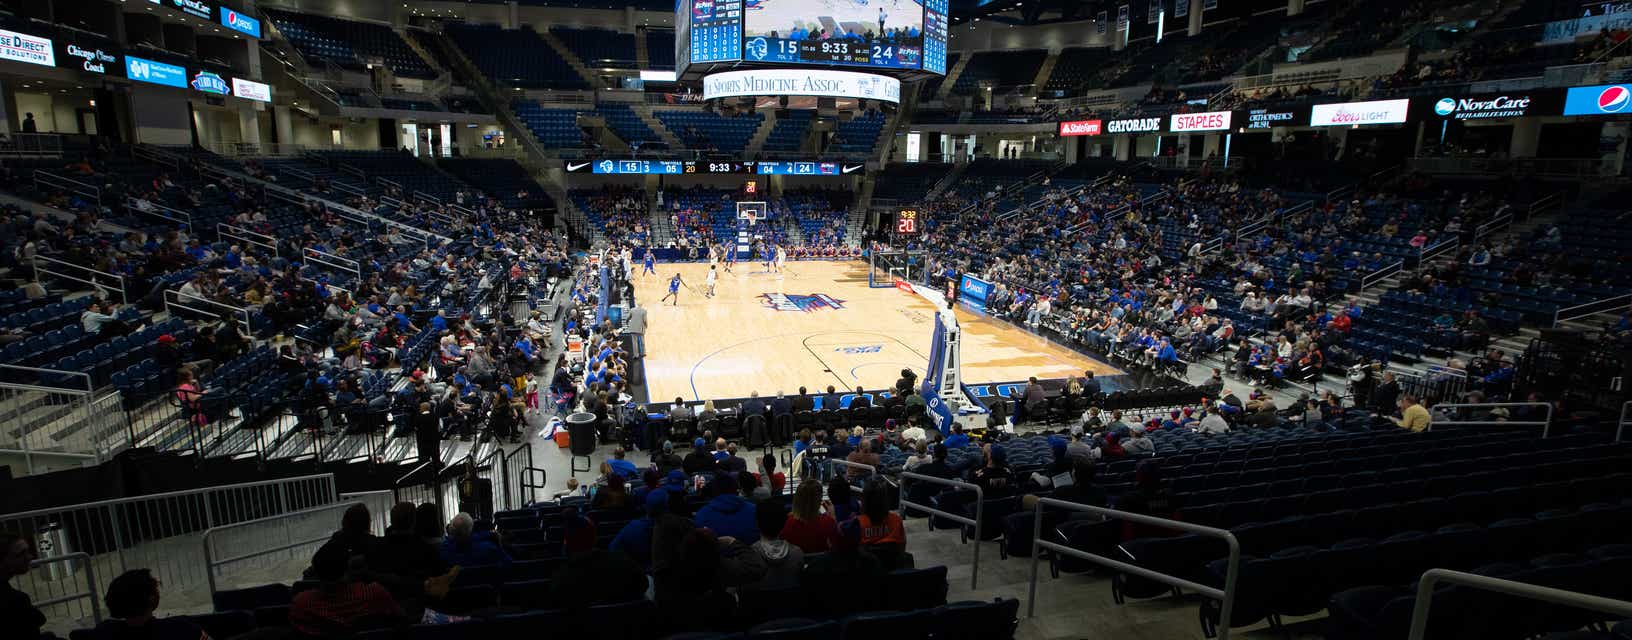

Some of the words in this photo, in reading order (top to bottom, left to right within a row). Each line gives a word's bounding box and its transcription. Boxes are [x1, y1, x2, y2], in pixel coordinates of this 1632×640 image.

[14, 35, 44, 51] DIRECT
[778, 40, 797, 53] 15
[822, 42, 848, 53] 9:33
[6, 48, 47, 62] SOLUTIONS
[67, 44, 96, 61] Chicago
[873, 46, 893, 59] 24
[84, 60, 105, 73] Coach
[744, 75, 799, 92] MEDICINE
[803, 75, 846, 93] ASSOC.
[1456, 96, 1530, 111] NovaCare
[1177, 114, 1223, 129] STAPLES
[1361, 111, 1388, 121] LIGHT
[1107, 118, 1161, 133] GATORADE
[626, 163, 637, 171] 15
[666, 165, 676, 173] 05
[685, 165, 696, 173] 20
[709, 163, 730, 172] 9:33
[799, 164, 810, 172] 24
[901, 210, 916, 219] 9:32
[899, 219, 914, 232] 20
